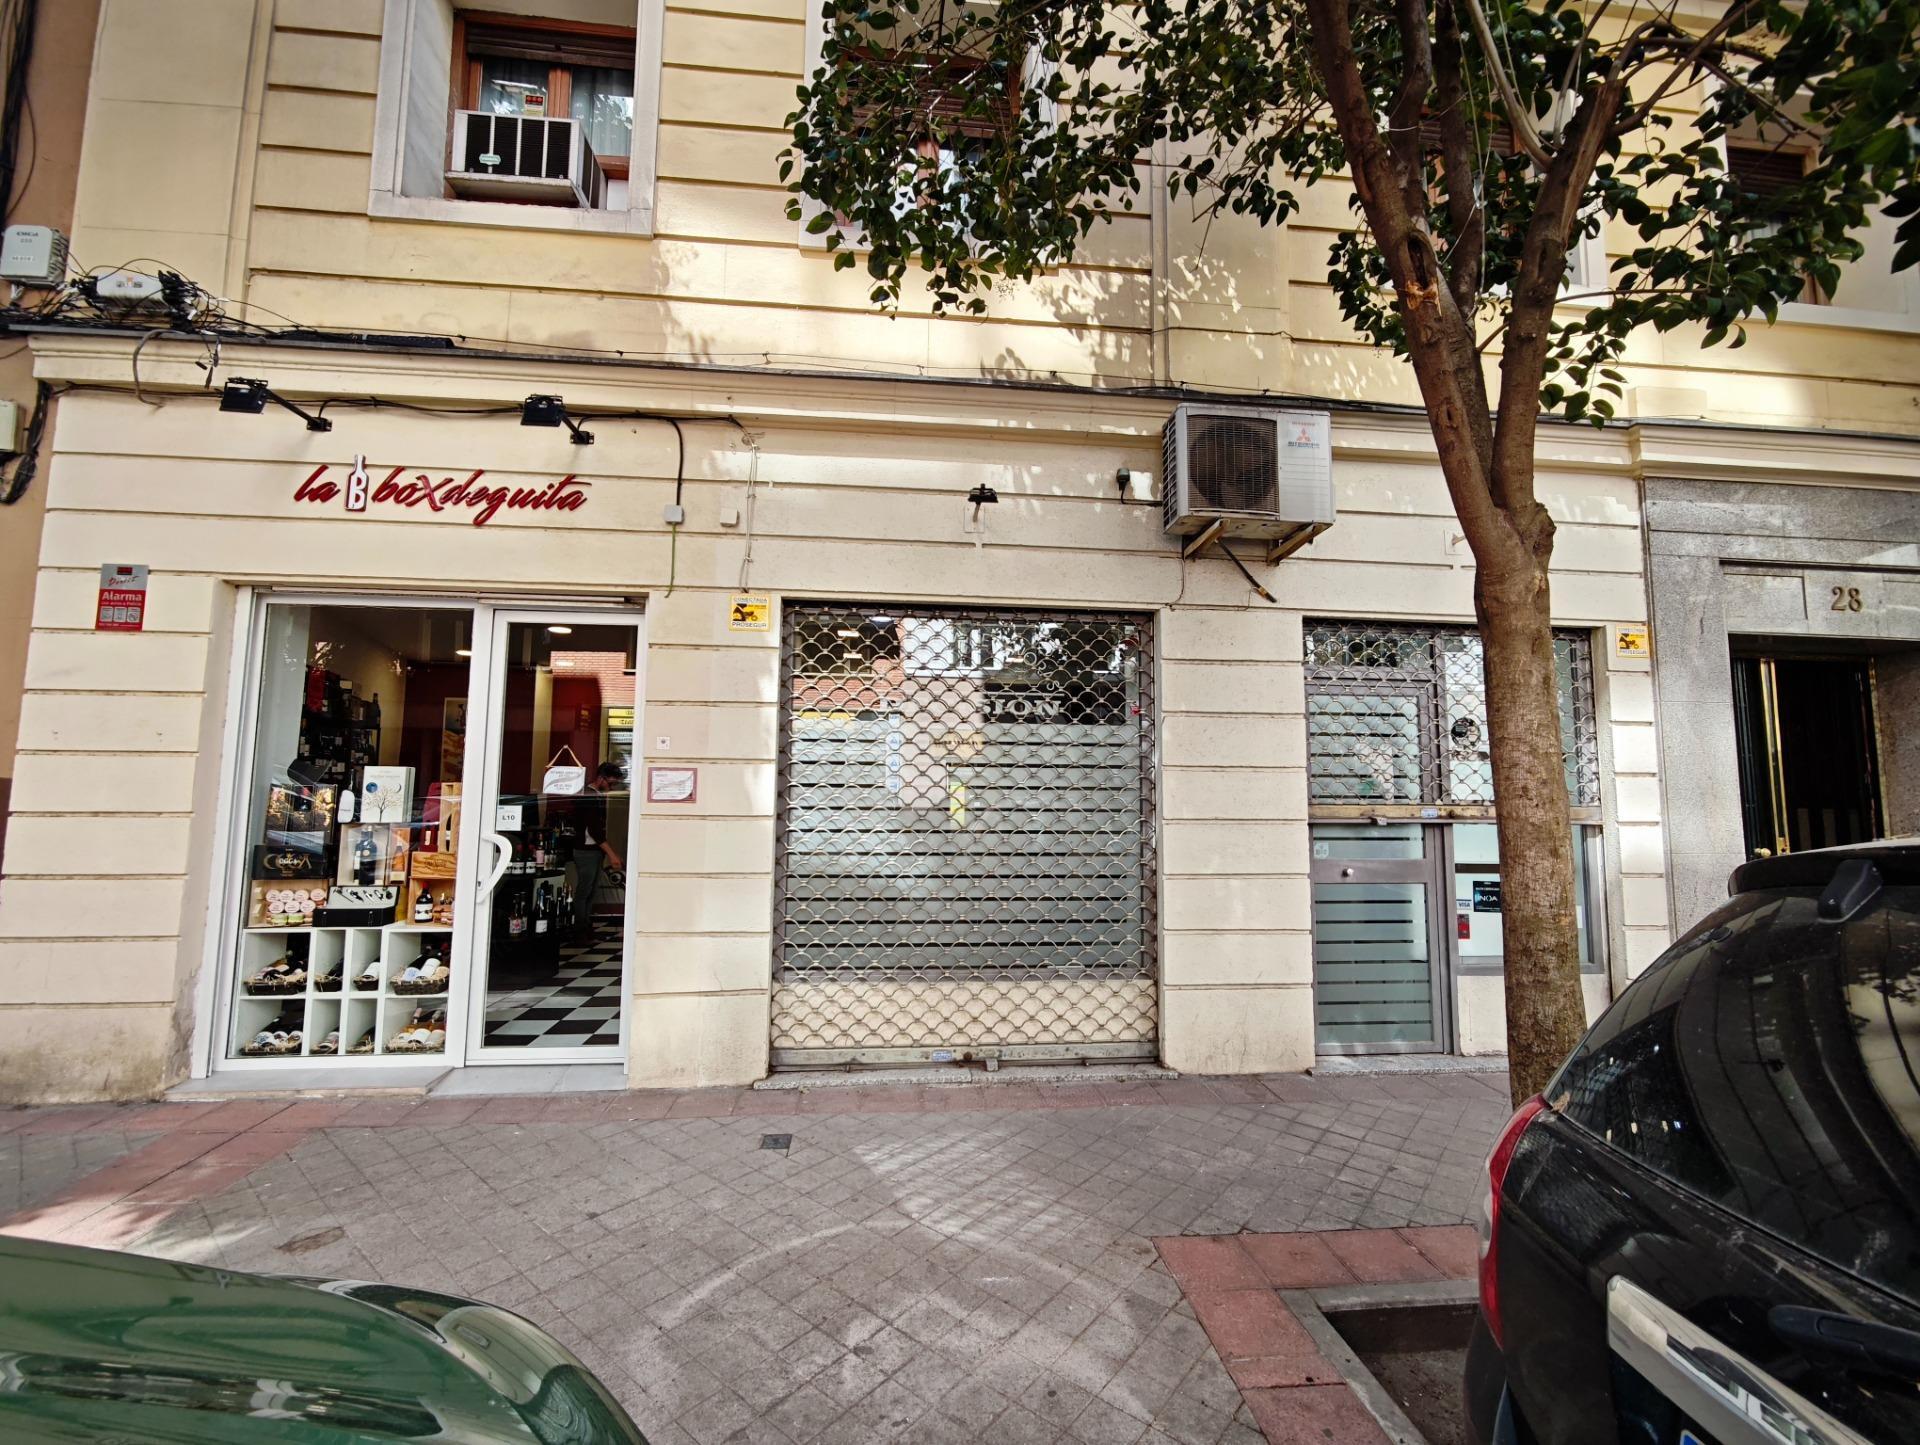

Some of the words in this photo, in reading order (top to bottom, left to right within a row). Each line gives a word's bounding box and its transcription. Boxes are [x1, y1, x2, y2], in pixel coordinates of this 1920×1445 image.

[293, 464, 341, 502] la
[102, 591, 142, 602] Alarma
[1831, 586, 1862, 612] 28
